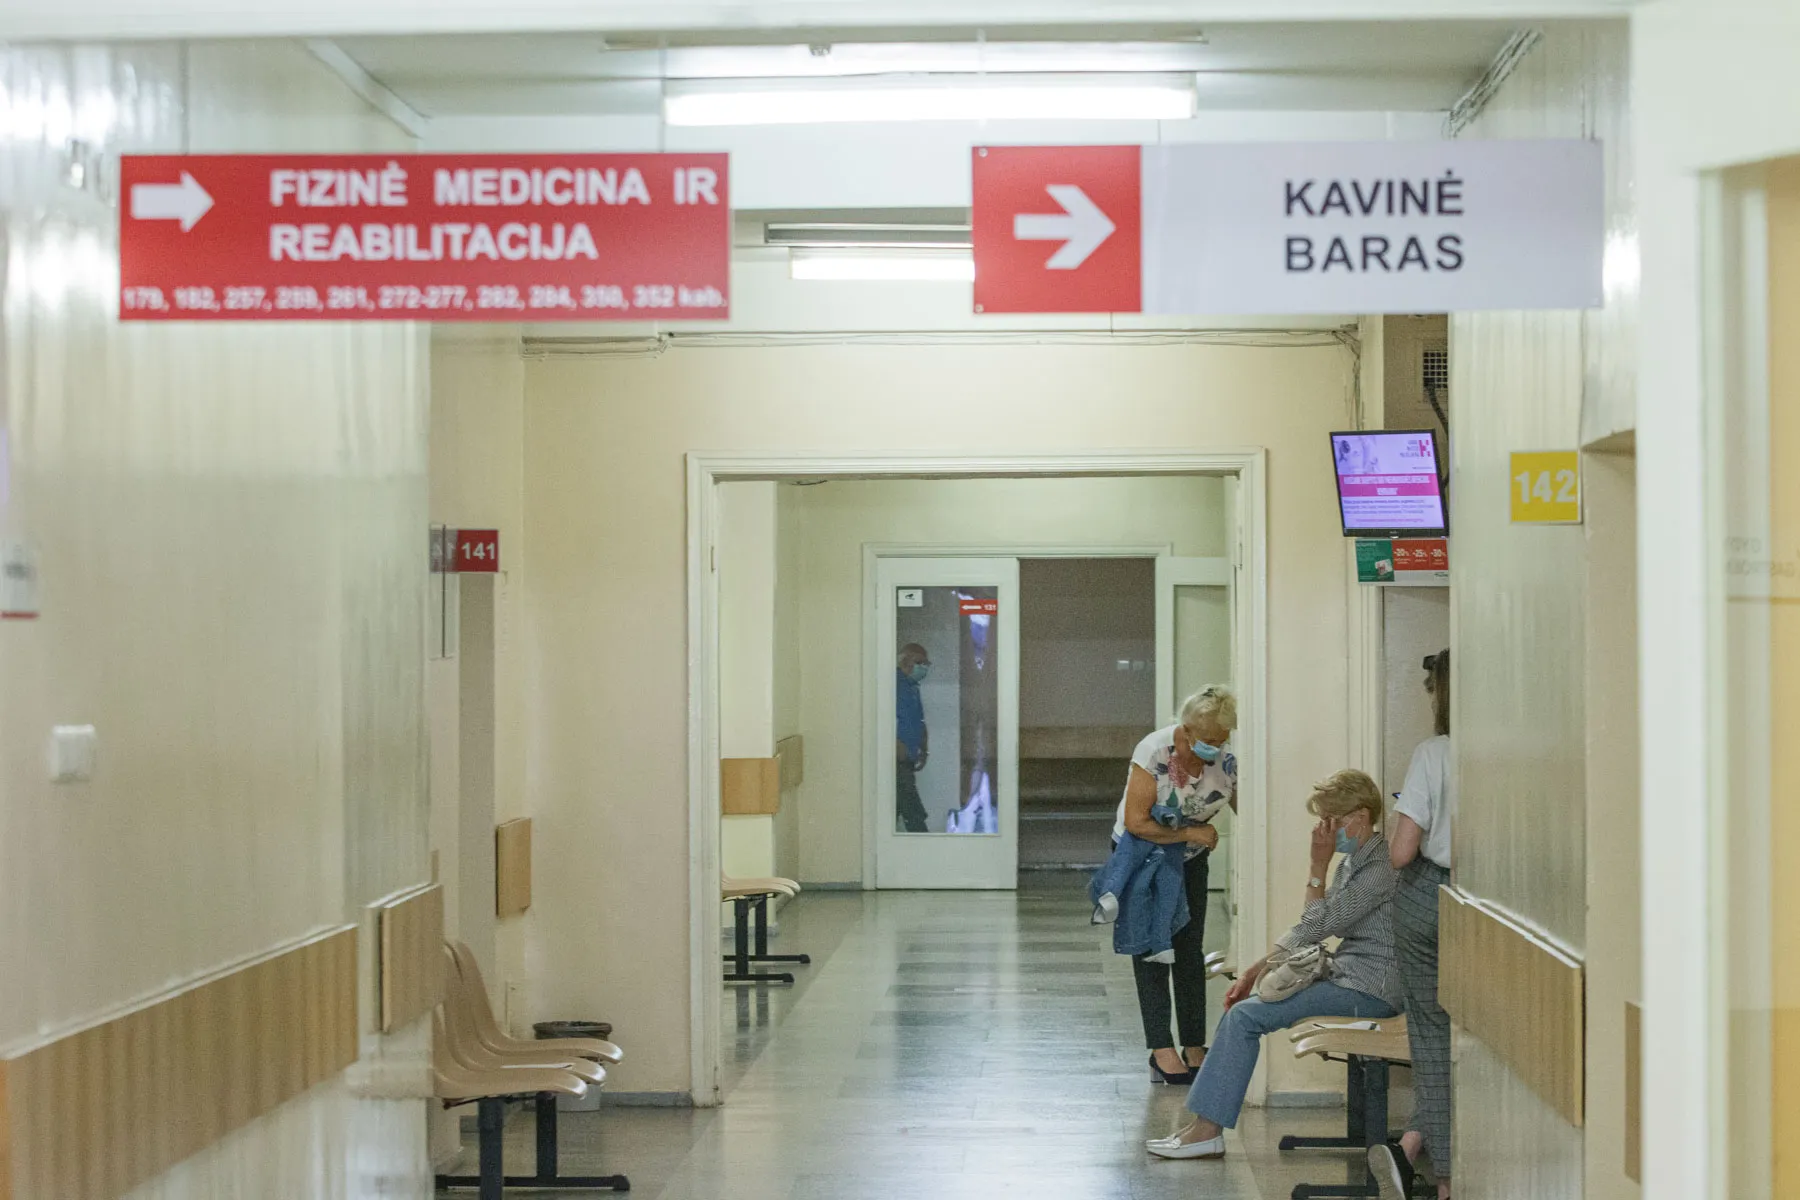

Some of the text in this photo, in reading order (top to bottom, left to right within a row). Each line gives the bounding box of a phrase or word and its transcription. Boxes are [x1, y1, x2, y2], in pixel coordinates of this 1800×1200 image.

[270, 161, 718, 206] FIZINĖ MEDICINA IR
[1285, 168, 1464, 216] KAVINĖ
[269, 223, 599, 261] REABILITACIJA
[1285, 235, 1465, 272] BARAS
[1515, 469, 1576, 504] 142
[461, 542, 495, 560] 141
